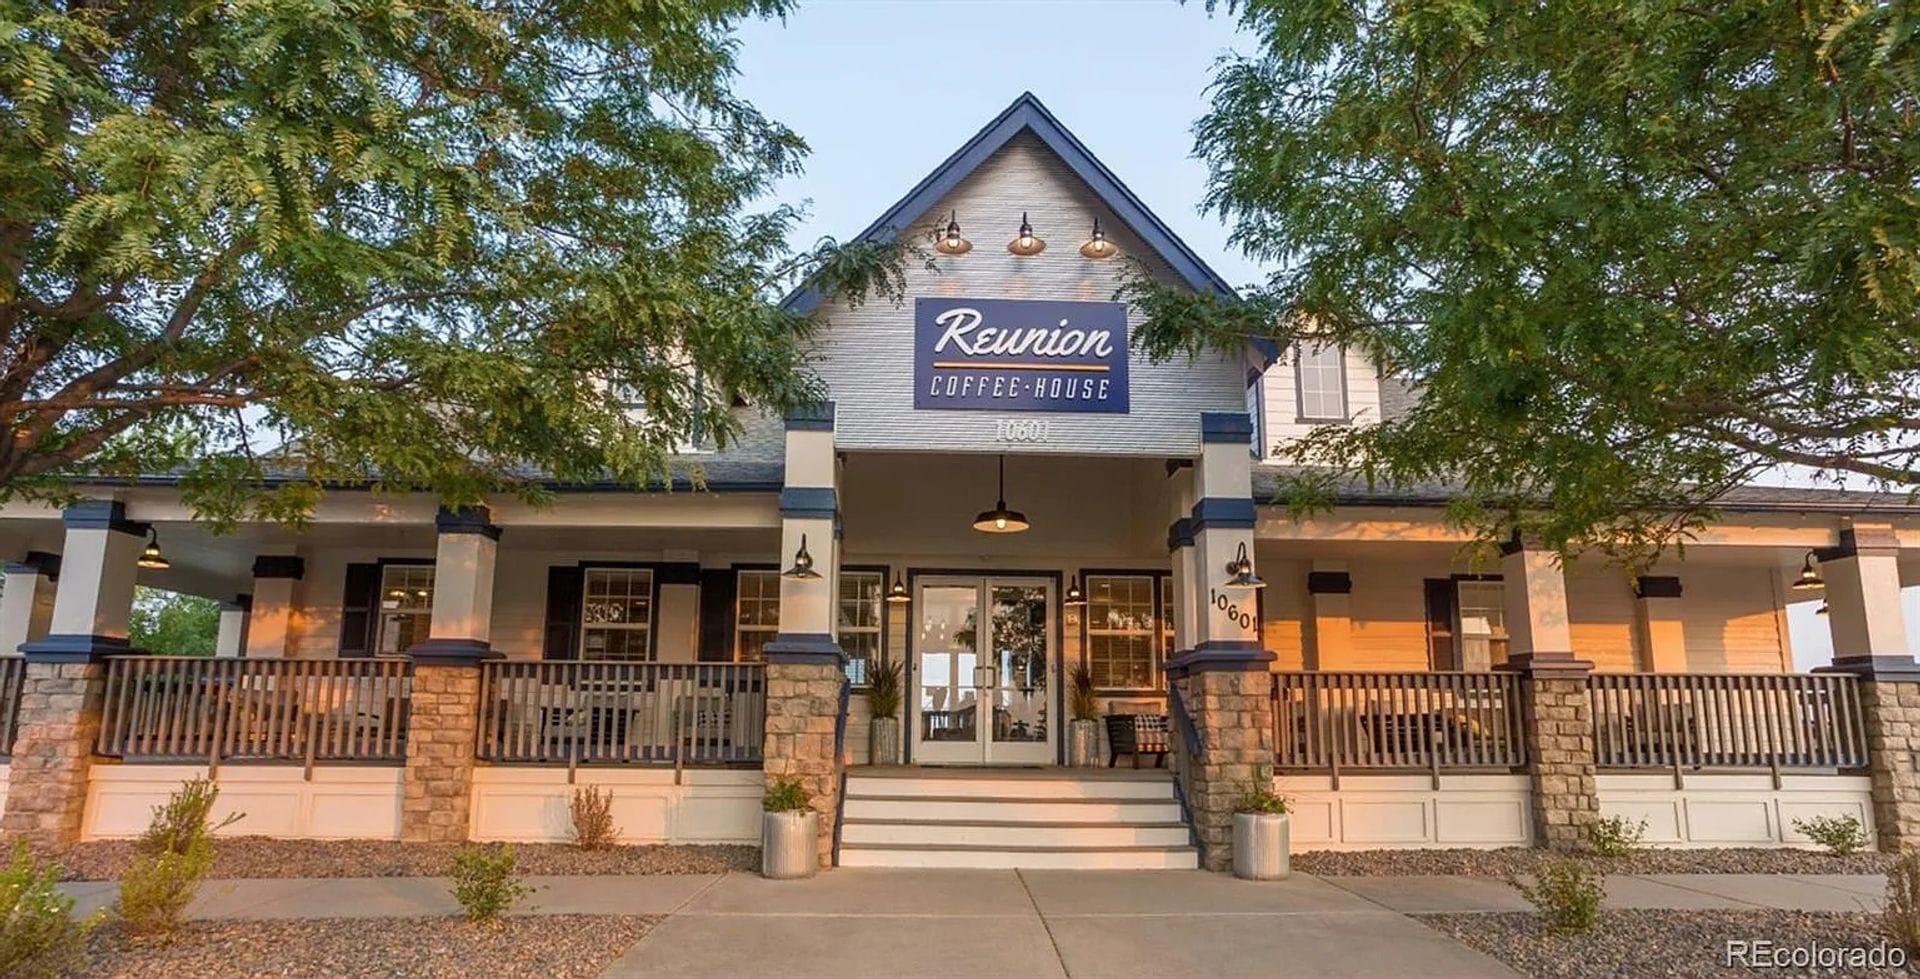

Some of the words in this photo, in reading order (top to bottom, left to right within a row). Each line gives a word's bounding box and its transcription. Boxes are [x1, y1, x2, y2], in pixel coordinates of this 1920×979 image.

[935, 308, 1112, 357] Reunion
[931, 376, 1020, 397] COFFEE
[1034, 378, 1110, 400] HOUSE
[996, 420, 1049, 443] 10601
[1211, 588, 1257, 632] 10601
